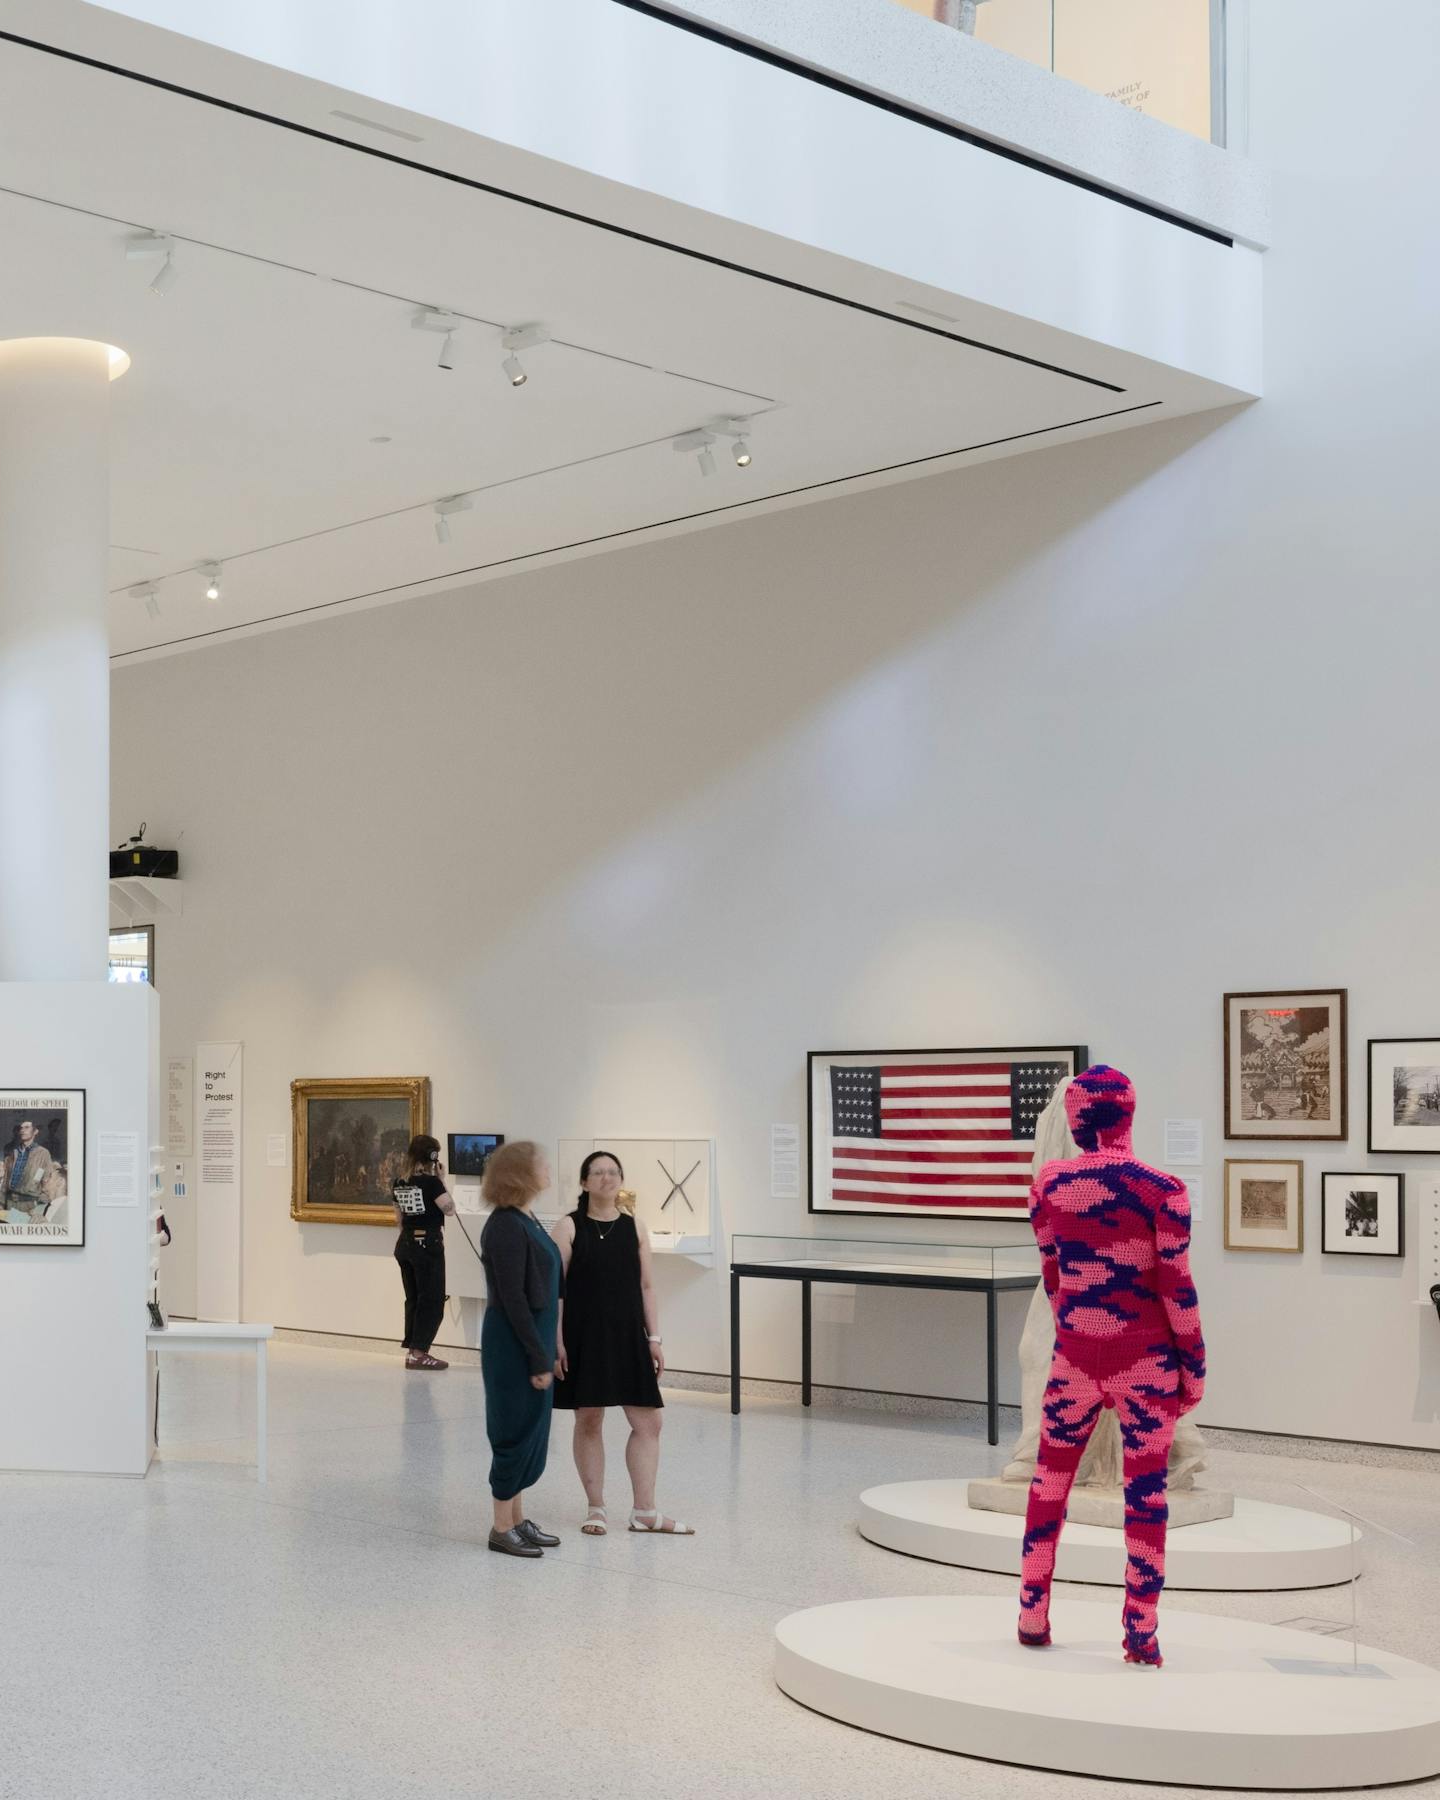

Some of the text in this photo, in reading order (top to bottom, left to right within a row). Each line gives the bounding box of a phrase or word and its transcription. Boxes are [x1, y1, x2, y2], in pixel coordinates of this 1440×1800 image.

[205, 1072, 226, 1080] Right
[30, 1099, 39, 1107] OF
[41, 1099, 68, 1107] SPEECH
[0, 1225, 23, 1235] WAR
[27, 1225, 68, 1236] BONDS
